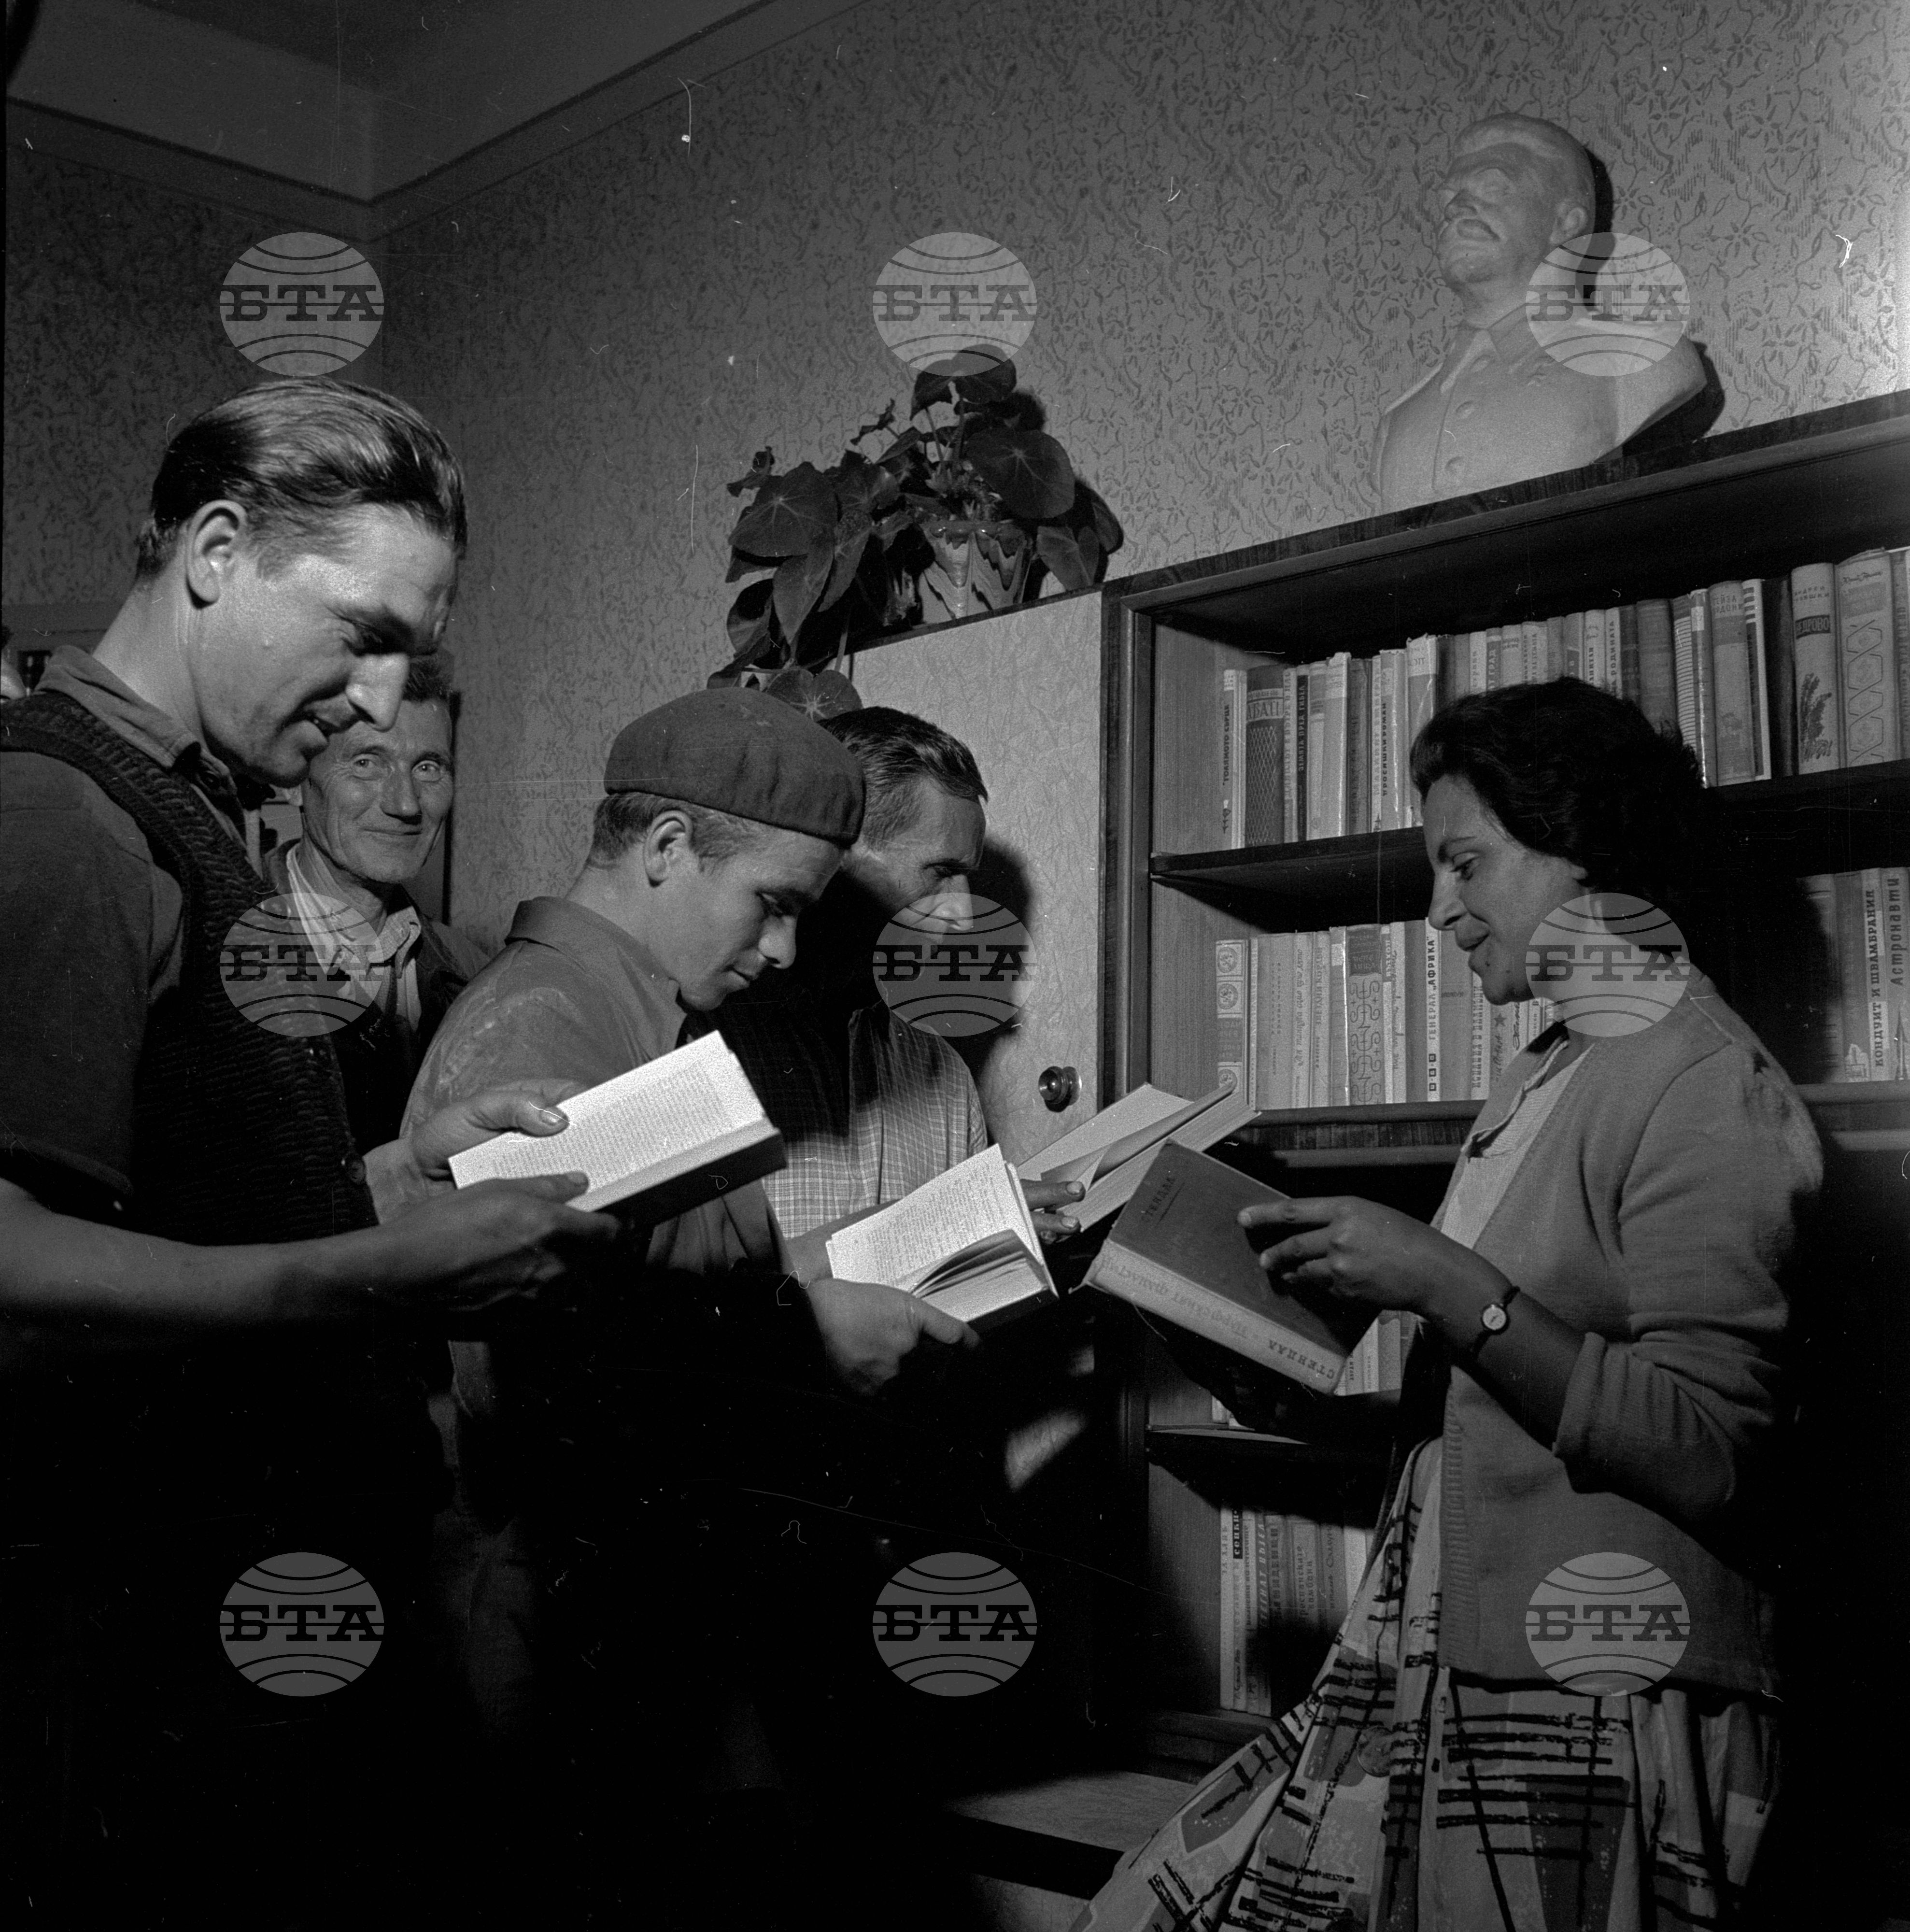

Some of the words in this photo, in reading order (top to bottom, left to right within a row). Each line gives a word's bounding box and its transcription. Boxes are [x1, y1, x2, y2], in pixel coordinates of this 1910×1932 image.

[1866, 890, 1880, 985] ШВАМБРАНИЯ
[1887, 879, 1908, 986] Астронавти
[1871, 988, 1880, 998] И
[1428, 994, 1436, 1040] ГЕНЕРАЛ
[1873, 1003, 1883, 1066] КОНДУИТ
[1268, 1339, 1336, 1380] СТЕНДАЛ
[1258, 1523, 1266, 1564] ВЪЗЕЛ
